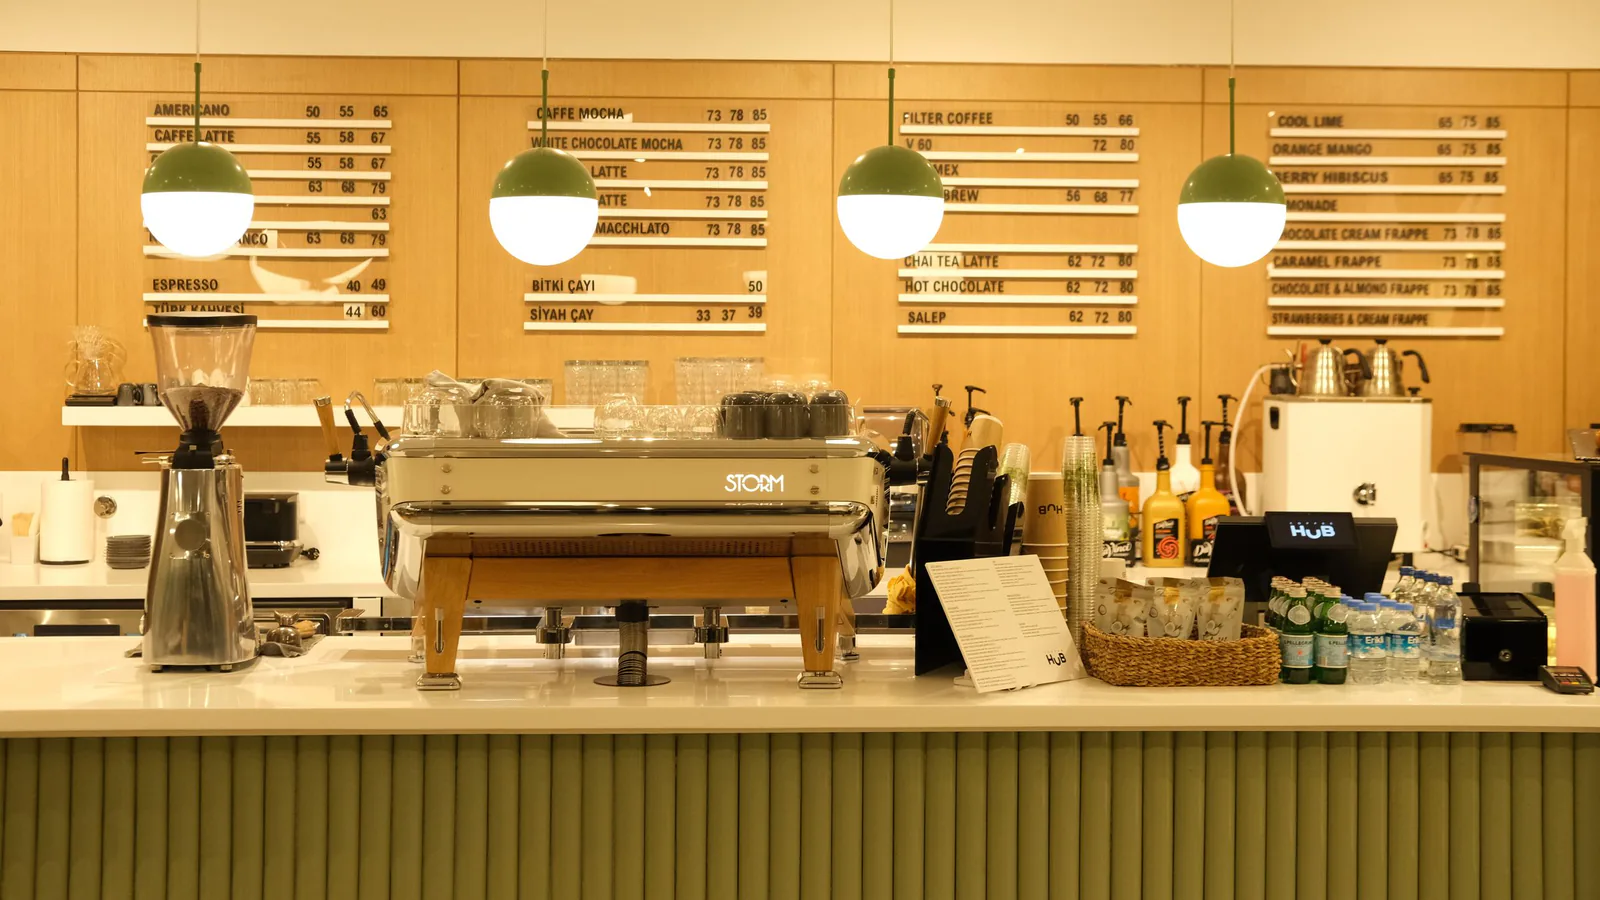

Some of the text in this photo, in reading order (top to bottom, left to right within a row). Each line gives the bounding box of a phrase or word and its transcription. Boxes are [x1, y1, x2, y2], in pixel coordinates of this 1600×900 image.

[306, 106, 320, 117] 50
[339, 106, 354, 117] 55
[373, 106, 388, 117] 65
[536, 107, 766, 120] CAFFE MOCHA 73 78 85
[903, 112, 1133, 126] FILTER COFFEE 50 55 66
[1278, 115, 1500, 128] COOL LIME 65 75 85
[154, 129, 193, 142] CAFFE
[306, 132, 321, 143] 55
[339, 132, 354, 143] 58
[371, 132, 386, 143] 67
[571, 137, 637, 149] CHOCOLATE
[641, 138, 683, 150] MOCHA
[707, 138, 721, 149] 73
[728, 138, 743, 149] 78
[751, 138, 766, 149] 85
[906, 138, 1134, 151] V 60 72 80
[1273, 143, 1501, 155] ORANGE MANGO 65 75 85
[307, 157, 386, 169] 55 58 67
[591, 166, 766, 179] LATTE 73 78 85
[1323, 172, 1388, 183] HIBISCUS
[1438, 172, 1453, 183] 65
[1460, 171, 1474, 183] 75
[1484, 171, 1498, 183] 85
[308, 181, 386, 194] 63 68 79
[598, 194, 764, 208] ATTE 73 78 85
[944, 189, 1134, 203] BREW 56 68 77
[1285, 200, 1338, 212] MONADE
[371, 208, 387, 219] 63
[595, 222, 765, 236] MACCHLATO 73 78 85
[1280, 229, 1338, 240] HOCOLATE
[1341, 229, 1381, 240] CREAM
[1385, 229, 1428, 240] FRAPPE
[1443, 228, 1456, 240] 73
[1466, 227, 1479, 239] 78
[306, 232, 321, 244] 63
[340, 232, 355, 244] 68
[371, 234, 386, 245] 79
[904, 255, 1132, 268] CHAI TEA LATTE 62 72 80
[1273, 256, 1330, 268] CARAMEL
[1335, 256, 1381, 268] FRAPPE
[1443, 256, 1456, 268] 73
[1487, 256, 1501, 268] 85
[152, 279, 386, 292] ESPRESSO 40 49
[532, 277, 763, 294] BİTKİ ÇAYI 50
[905, 281, 1134, 294] HOT CHOCOLATE 62 72 80
[1272, 283, 1500, 297] CHOCOLATE & ALMOND FRAPPE 73 78 85
[346, 307, 361, 317] 44
[371, 306, 386, 317] 60
[530, 306, 763, 323] SİYAH ÇAY 33 37 39
[908, 311, 1132, 324] SALEP 62 72 80
[1272, 313, 1428, 326] STRAWBERRIES & CREAM FRAPPE
[724, 474, 784, 492] STORM
[1290, 524, 1336, 540] HUB
[1045, 652, 1067, 666] HUB
